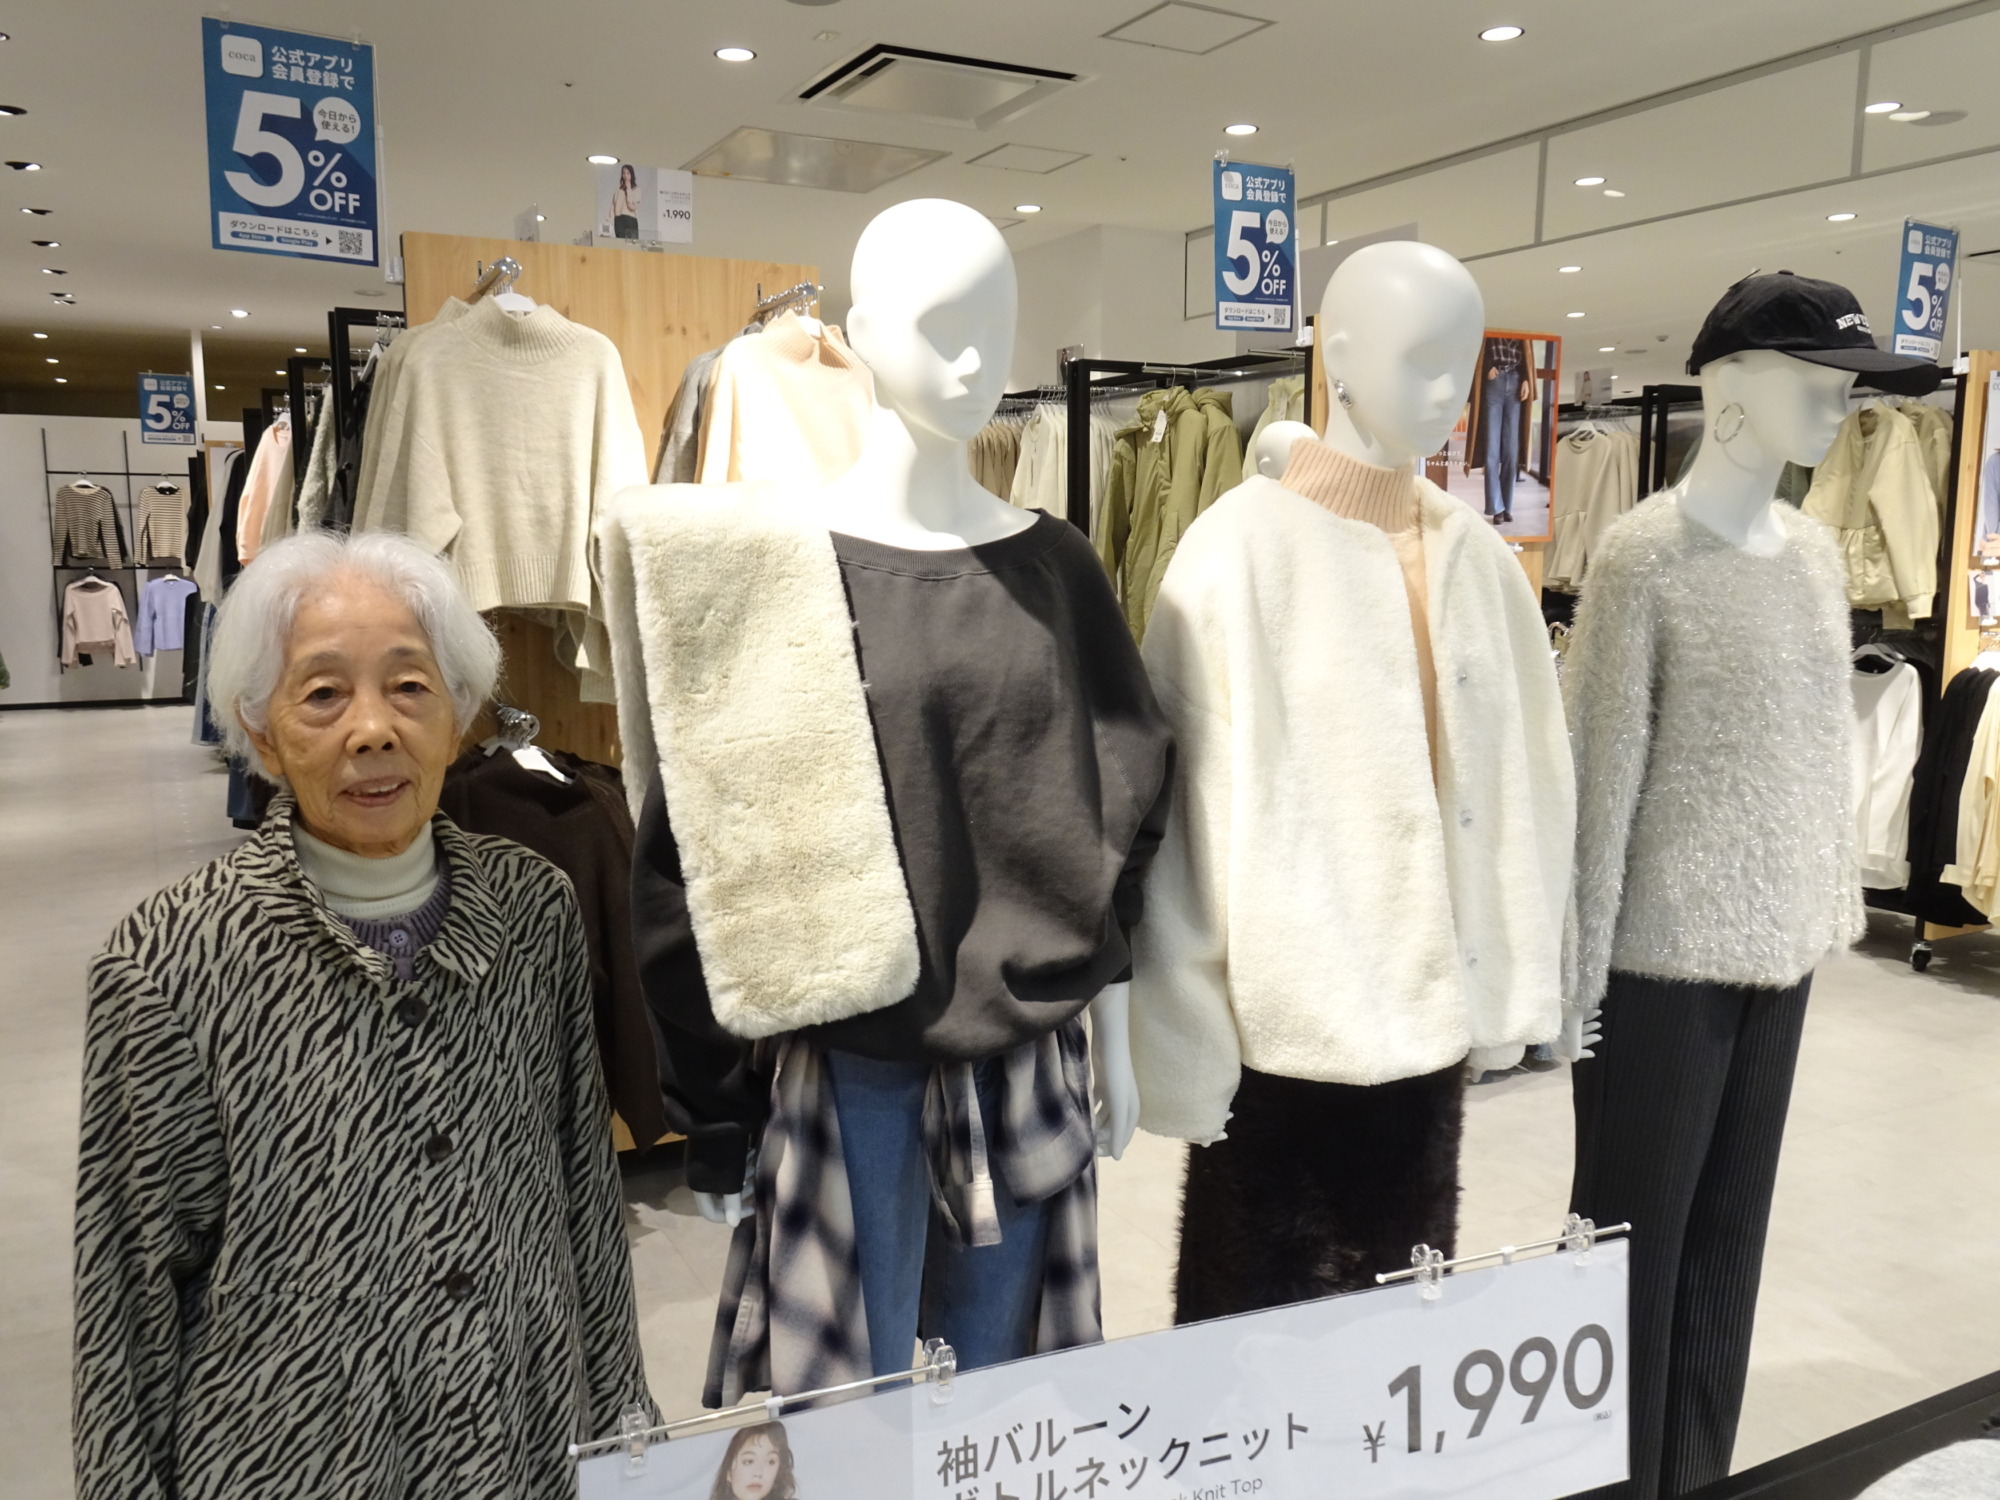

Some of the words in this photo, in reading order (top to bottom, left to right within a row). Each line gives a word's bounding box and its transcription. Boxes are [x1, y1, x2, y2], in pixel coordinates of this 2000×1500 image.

[228, 51, 256, 63] coca
[271, 46, 353, 73] 公式アプリ
[271, 63, 355, 90] 会員登録で
[318, 109, 357, 123] 今日から
[321, 121, 355, 134] 使える!
[224, 90, 306, 208] 5
[308, 150, 348, 189] %
[1246, 175, 1286, 191] 公式アプリ
[309, 189, 361, 215] OFF
[230, 219, 319, 238] ダウンロードはこちら
[1222, 210, 1261, 296] 5
[1261, 250, 1281, 277] %
[1261, 278, 1287, 295] OFF
[1902, 262, 1933, 331] 5
[1931, 295, 1943, 317] %
[1929, 318, 1943, 333] OFF
[145, 394, 172, 430] 5
[172, 410, 186, 422] %
[172, 422, 190, 430] OFF
[936, 1403, 1150, 1487] 袖バルーン
[1230, 1478, 1263, 1495] Top
